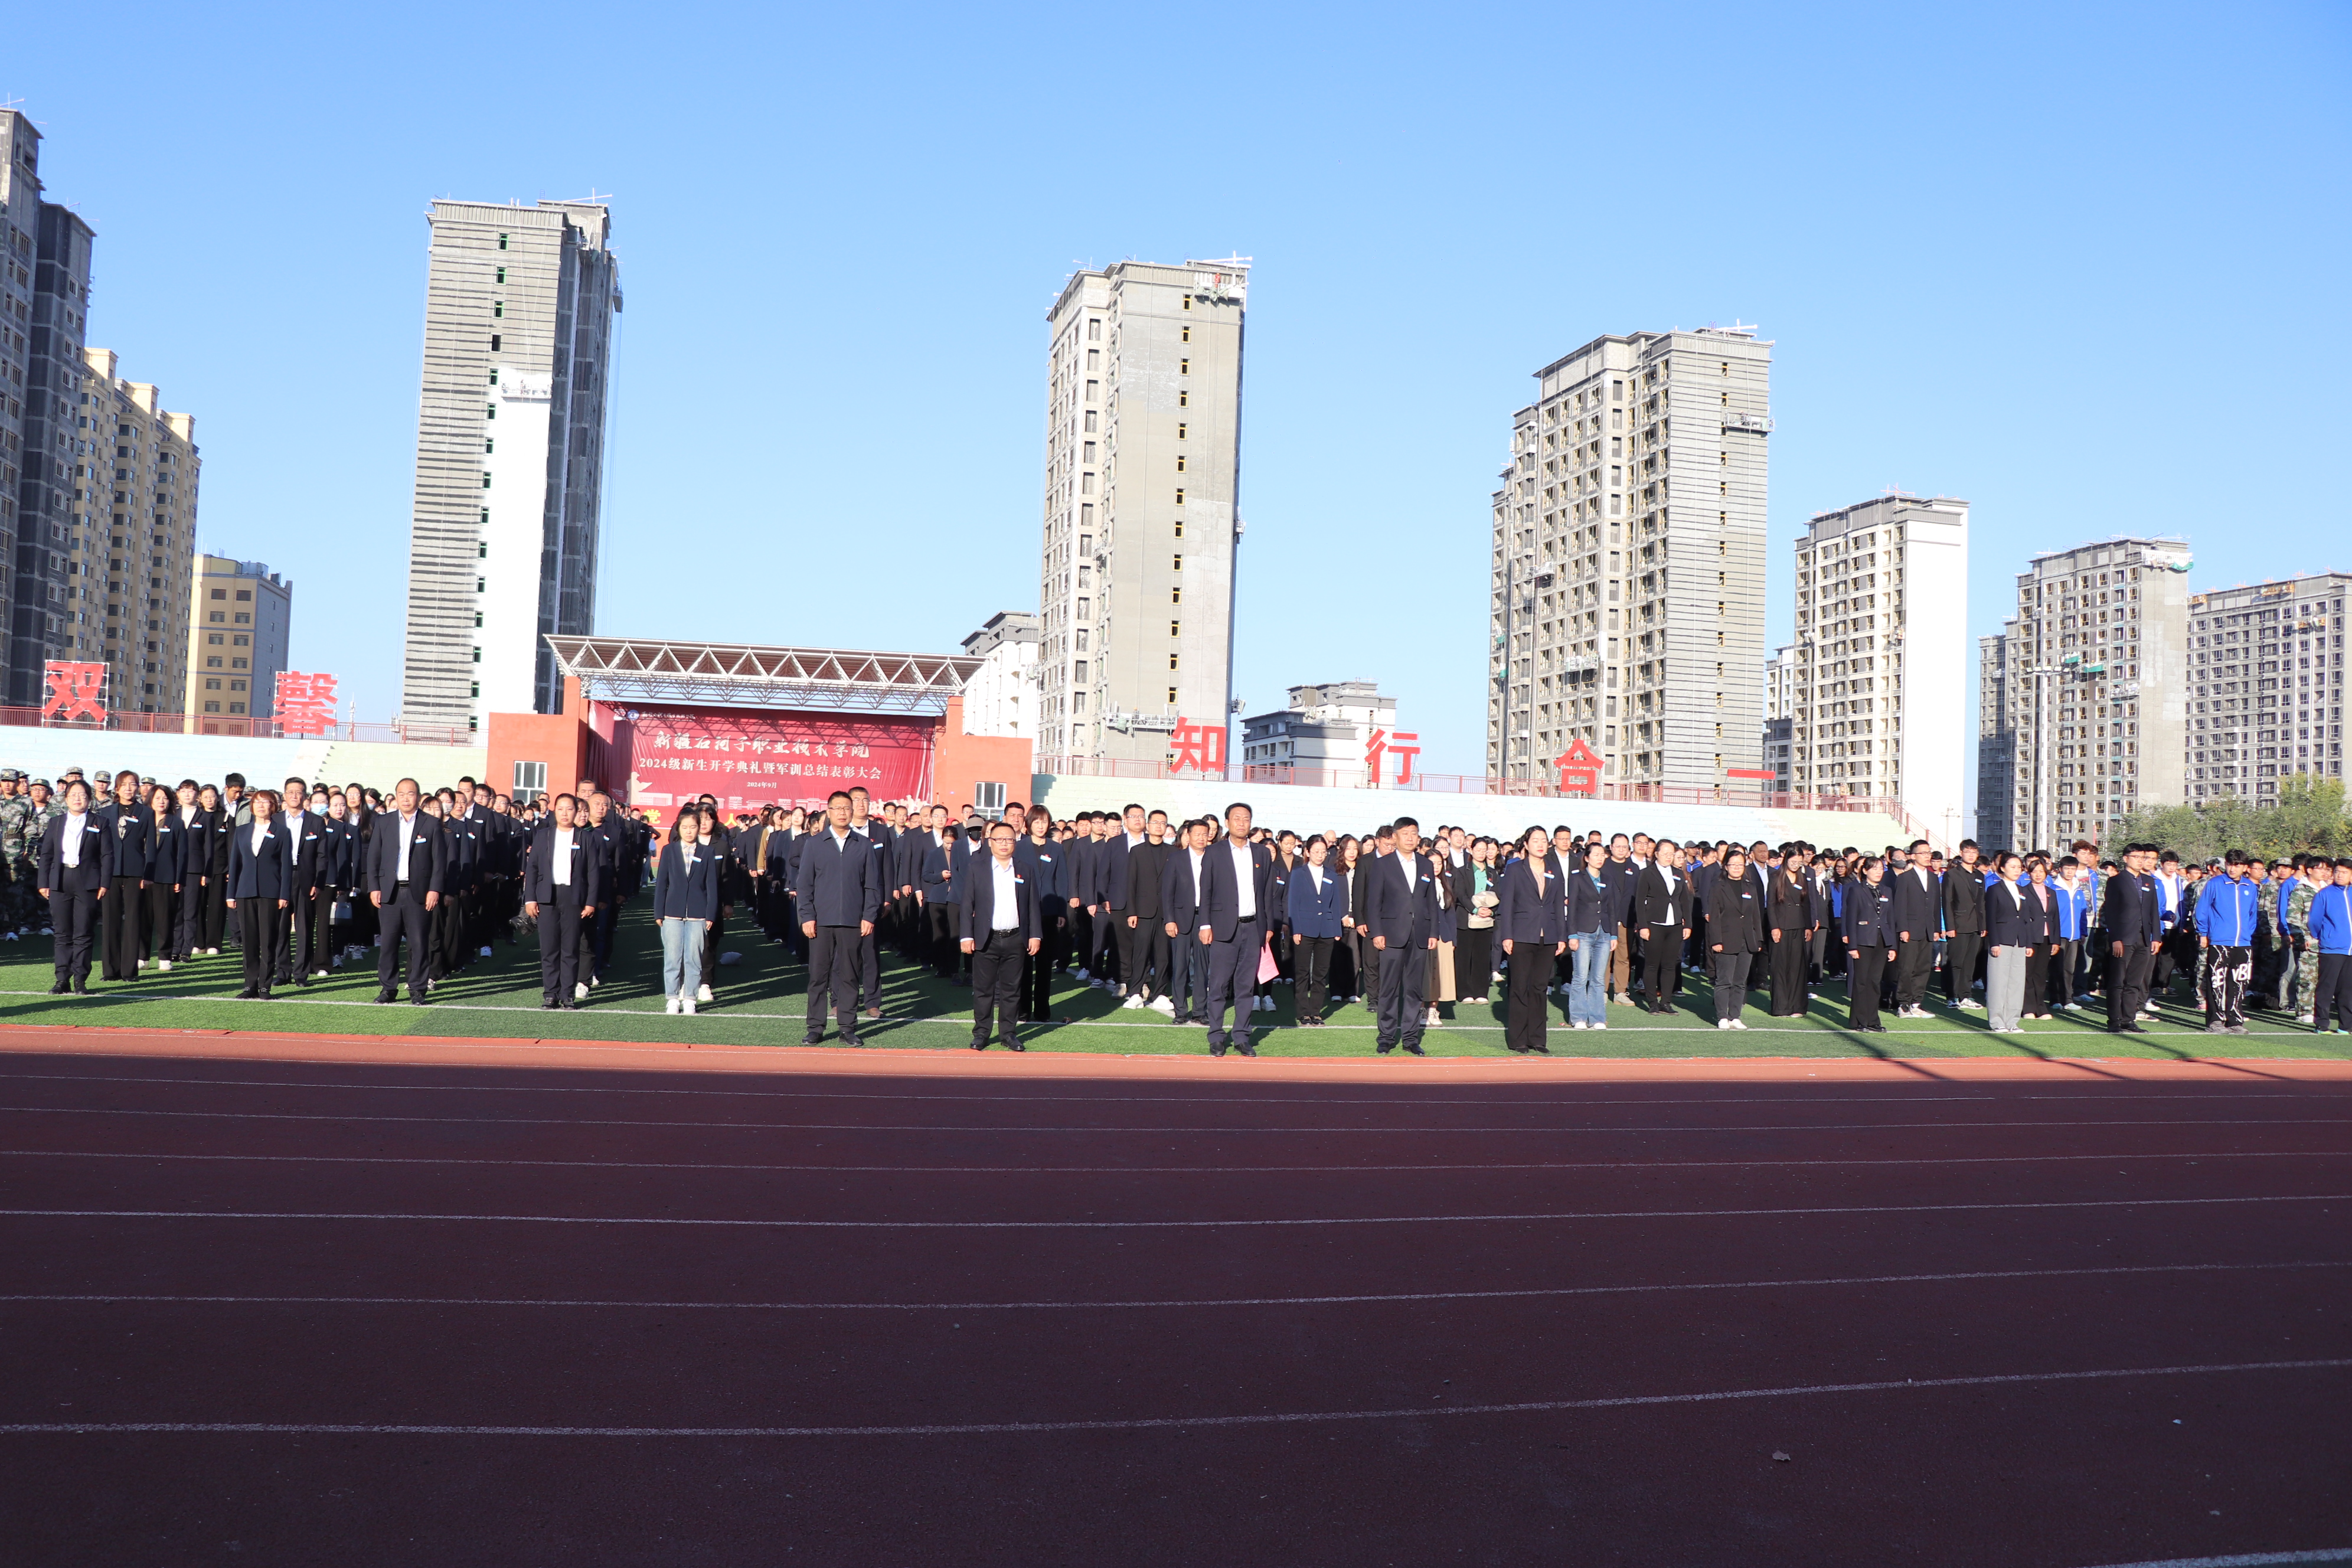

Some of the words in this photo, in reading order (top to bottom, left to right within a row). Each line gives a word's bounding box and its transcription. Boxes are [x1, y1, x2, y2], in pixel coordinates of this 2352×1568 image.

[41, 662, 108, 721] 双
[272, 671, 338, 736] 馨
[654, 730, 870, 758] 新疆石河子职业技术学院
[1169, 716, 1226, 774] 知
[1364, 729, 1421, 785] 行
[1553, 739, 1606, 794] 合
[639, 757, 882, 779] 2024级新生开学典礼暨军训总结表彰大会
[644, 809, 661, 824] 党
